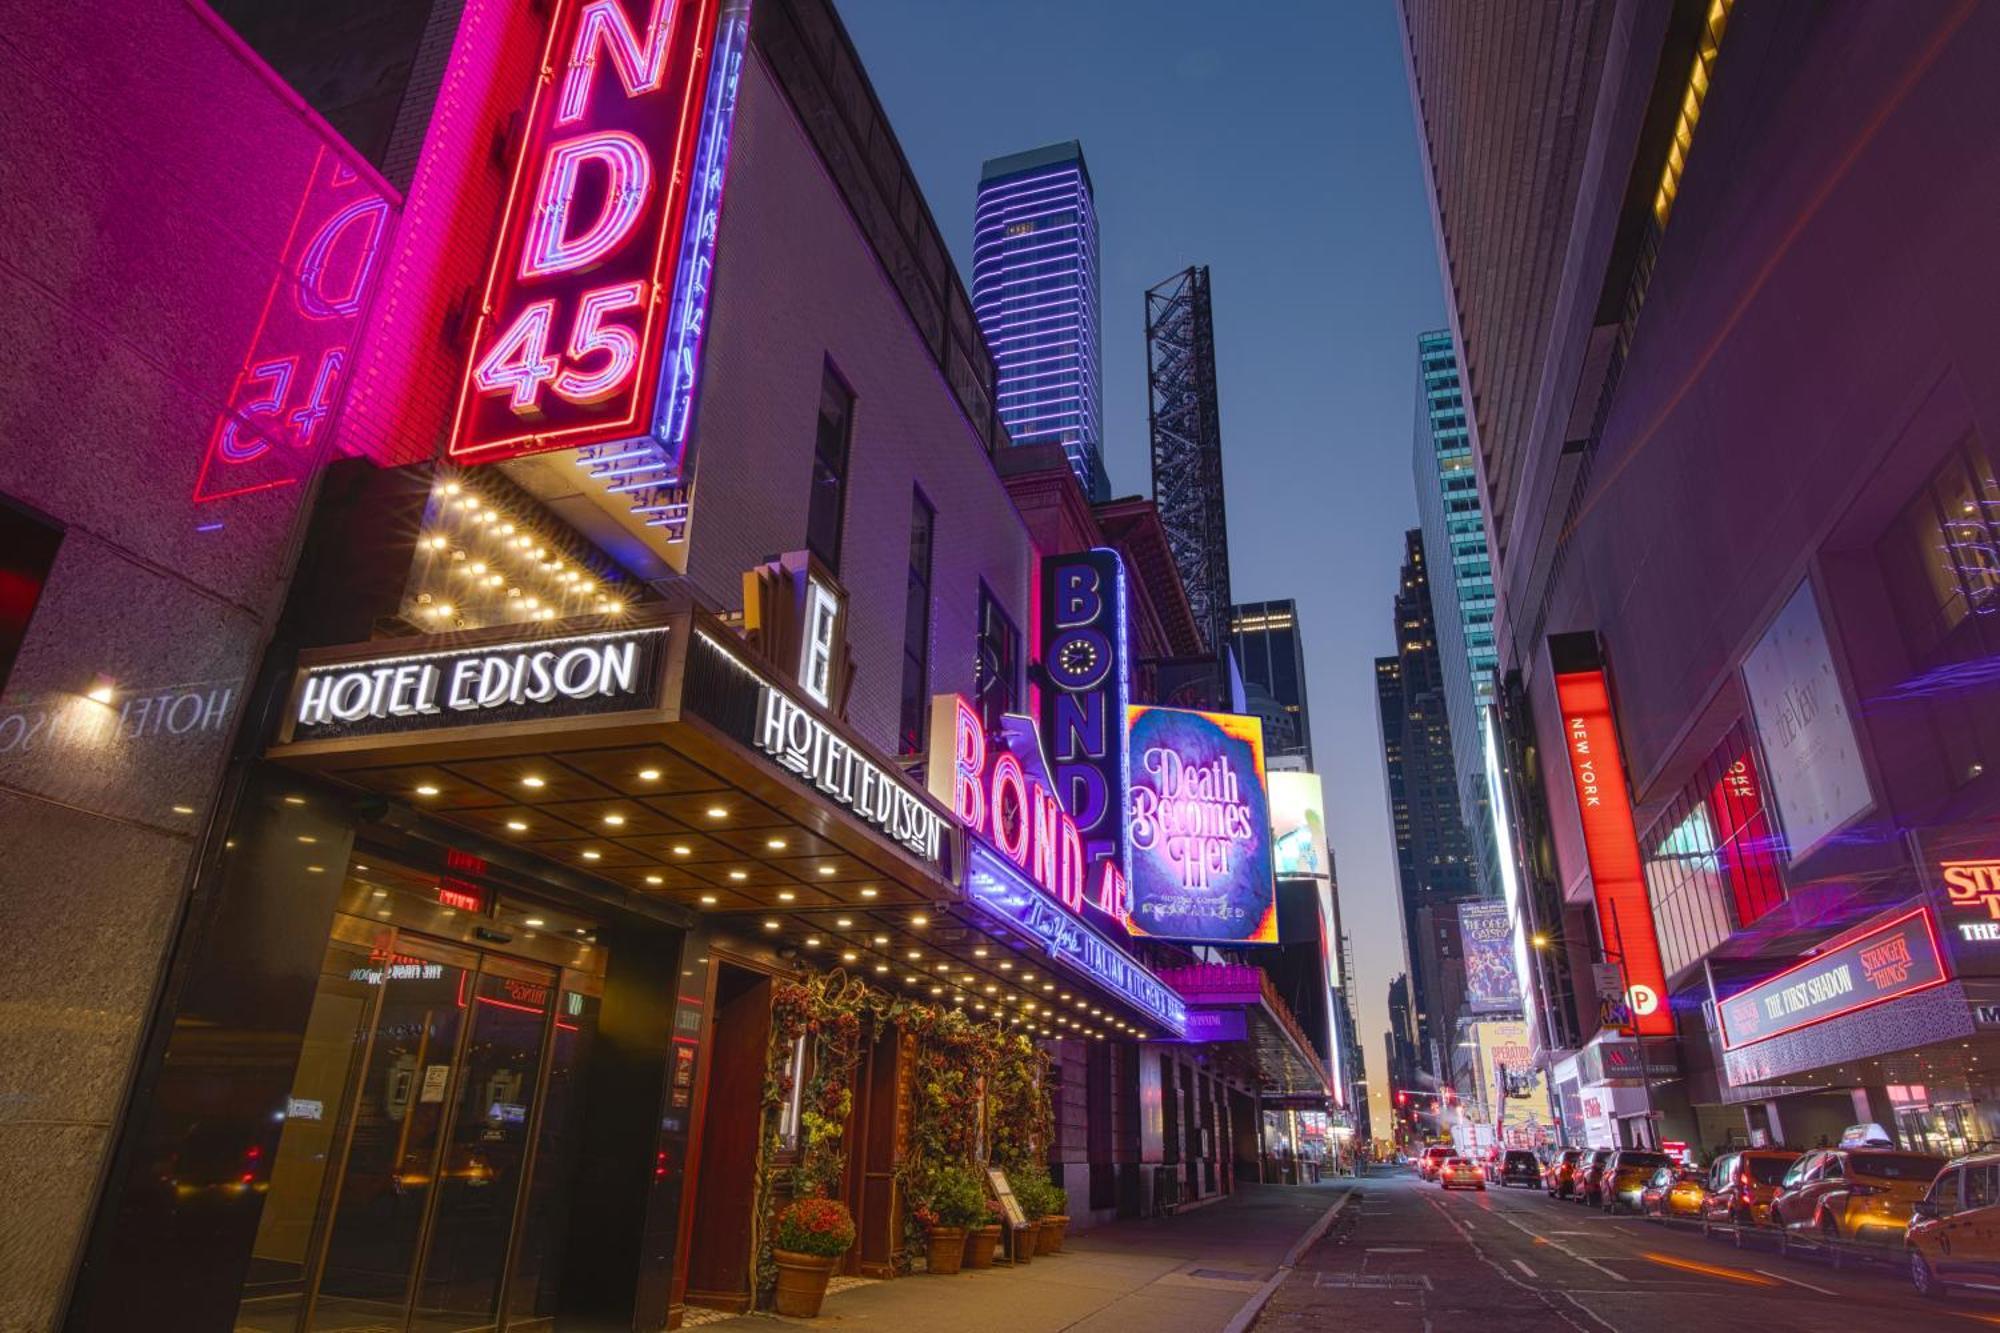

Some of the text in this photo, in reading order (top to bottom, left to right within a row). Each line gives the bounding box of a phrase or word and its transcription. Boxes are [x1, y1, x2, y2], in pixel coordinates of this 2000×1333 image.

[474, 280, 650, 416] 45
[298, 641, 640, 725] HOTEL EDISON
[1047, 564, 1113, 833] BOND
[763, 686, 940, 861] HOTEL EDISON
[1143, 747, 1240, 803] Death
[1571, 717, 1600, 807] NEW YORK
[953, 697, 1083, 916] BOND
[1128, 785, 1252, 850] Becomes
[1167, 836, 1233, 890] Her
[1084, 935, 1124, 988] ITALIAN
[1860, 937, 1912, 977] STRANGER
[1958, 923, 2000, 941] THE
[1764, 992, 1785, 1020] THE
[1782, 982, 1811, 1014] FIRST
[1807, 964, 1853, 1005] SHADOW
[1873, 962, 1908, 990] THINGS
